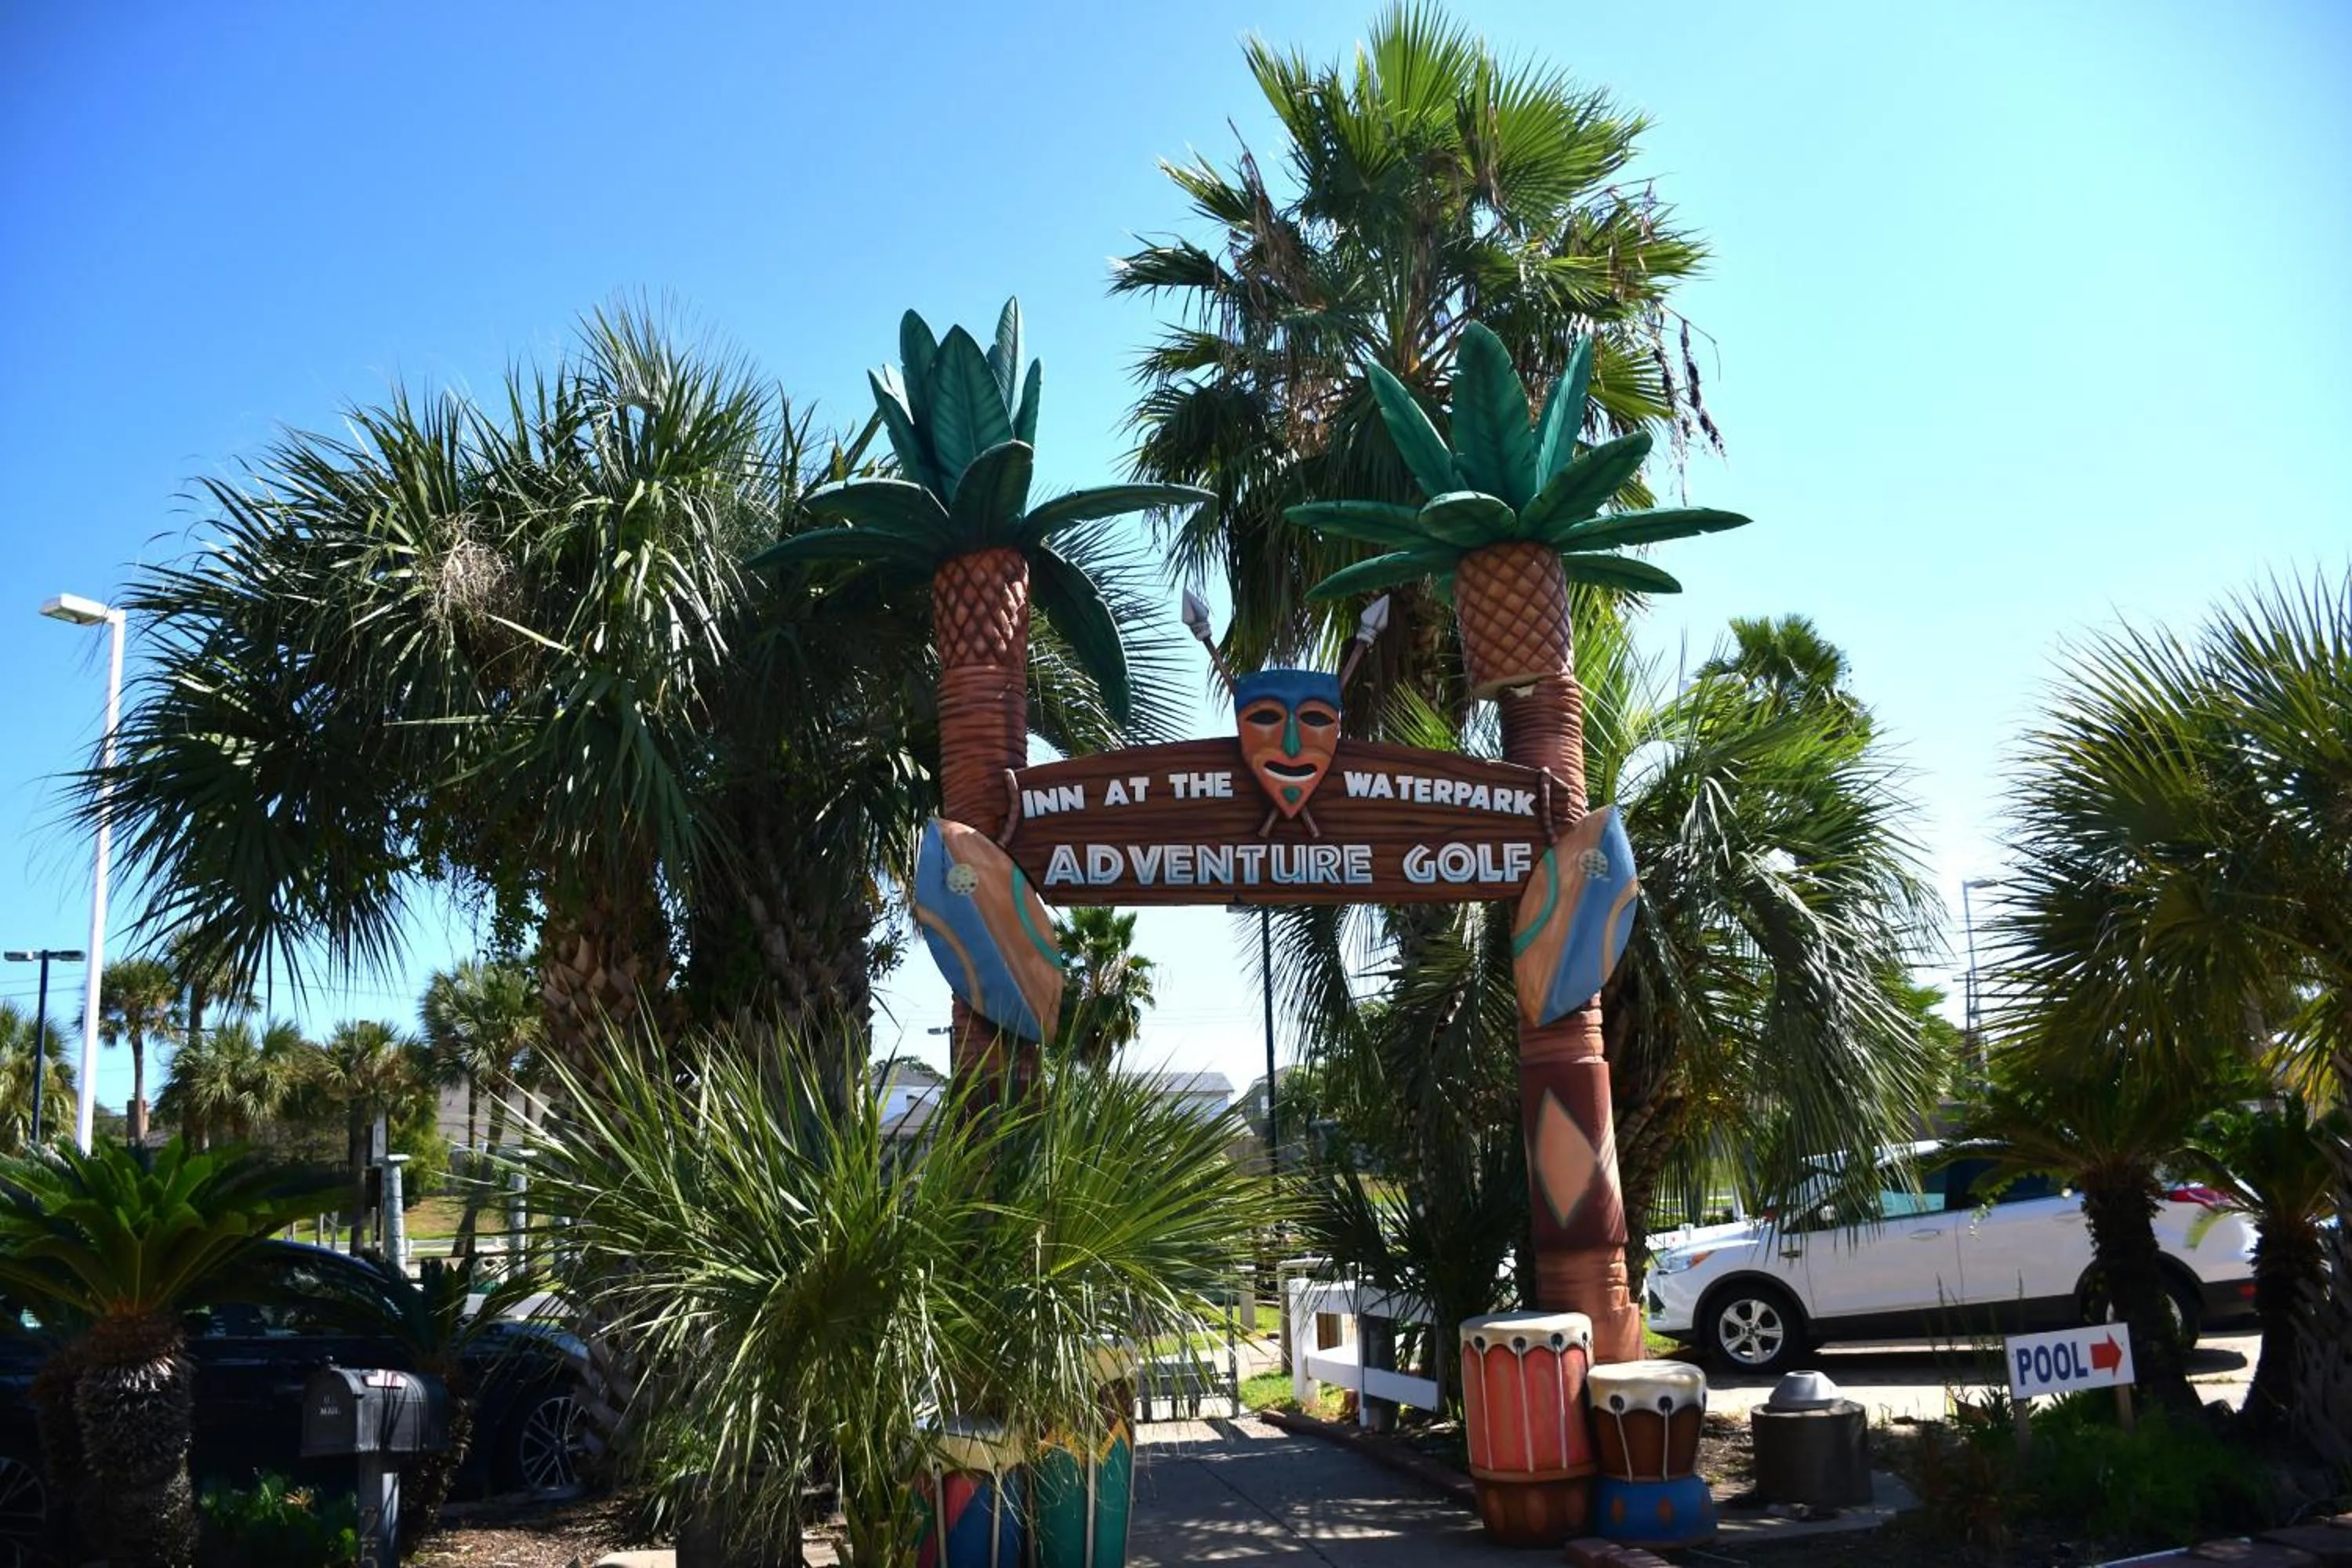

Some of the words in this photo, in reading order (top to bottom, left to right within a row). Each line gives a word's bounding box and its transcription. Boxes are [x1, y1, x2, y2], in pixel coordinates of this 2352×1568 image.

[1022, 785, 1085, 819] INN
[1104, 777, 1149, 806] AT
[1168, 771, 1233, 799] THE
[1343, 771, 1536, 816] WATERPARK
[1044, 844, 1373, 886] ADVENTURE
[1403, 842, 1532, 884] GOLF
[2016, 1341, 2089, 1385] POOL
